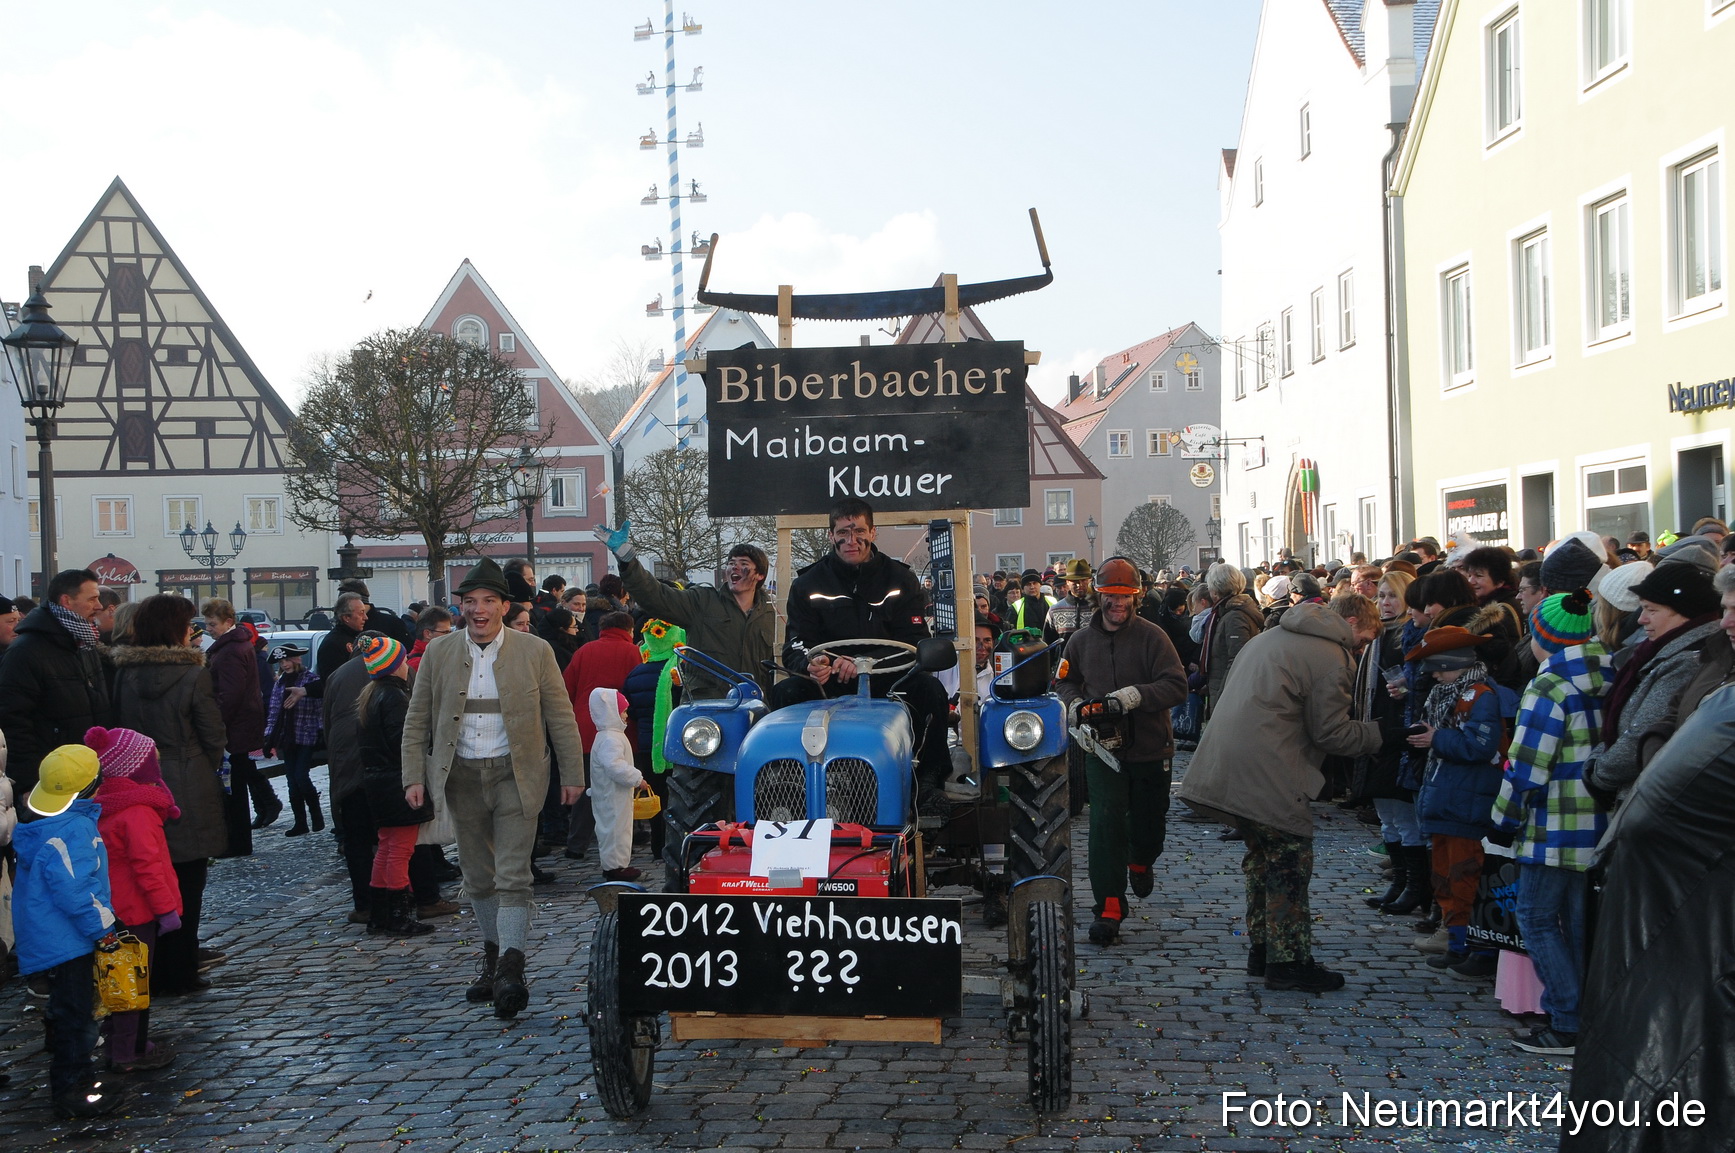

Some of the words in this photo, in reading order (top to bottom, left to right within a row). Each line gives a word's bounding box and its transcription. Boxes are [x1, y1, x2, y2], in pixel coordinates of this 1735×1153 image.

[717, 358, 1011, 404] Biberbacher
[726, 425, 925, 460] Maibaam-
[829, 465, 952, 498] Klauer
[1448, 512, 1498, 535] HOFBAUER
[473, 533, 514, 544] Moden
[95, 565, 137, 585] Splash
[271, 571, 292, 580] Bistro
[818, 882, 855, 892] KW6500
[640, 902, 739, 937] 2012
[752, 901, 962, 945] Viehhausen
[641, 950, 738, 989] 2013
[787, 950, 860, 993] ???
